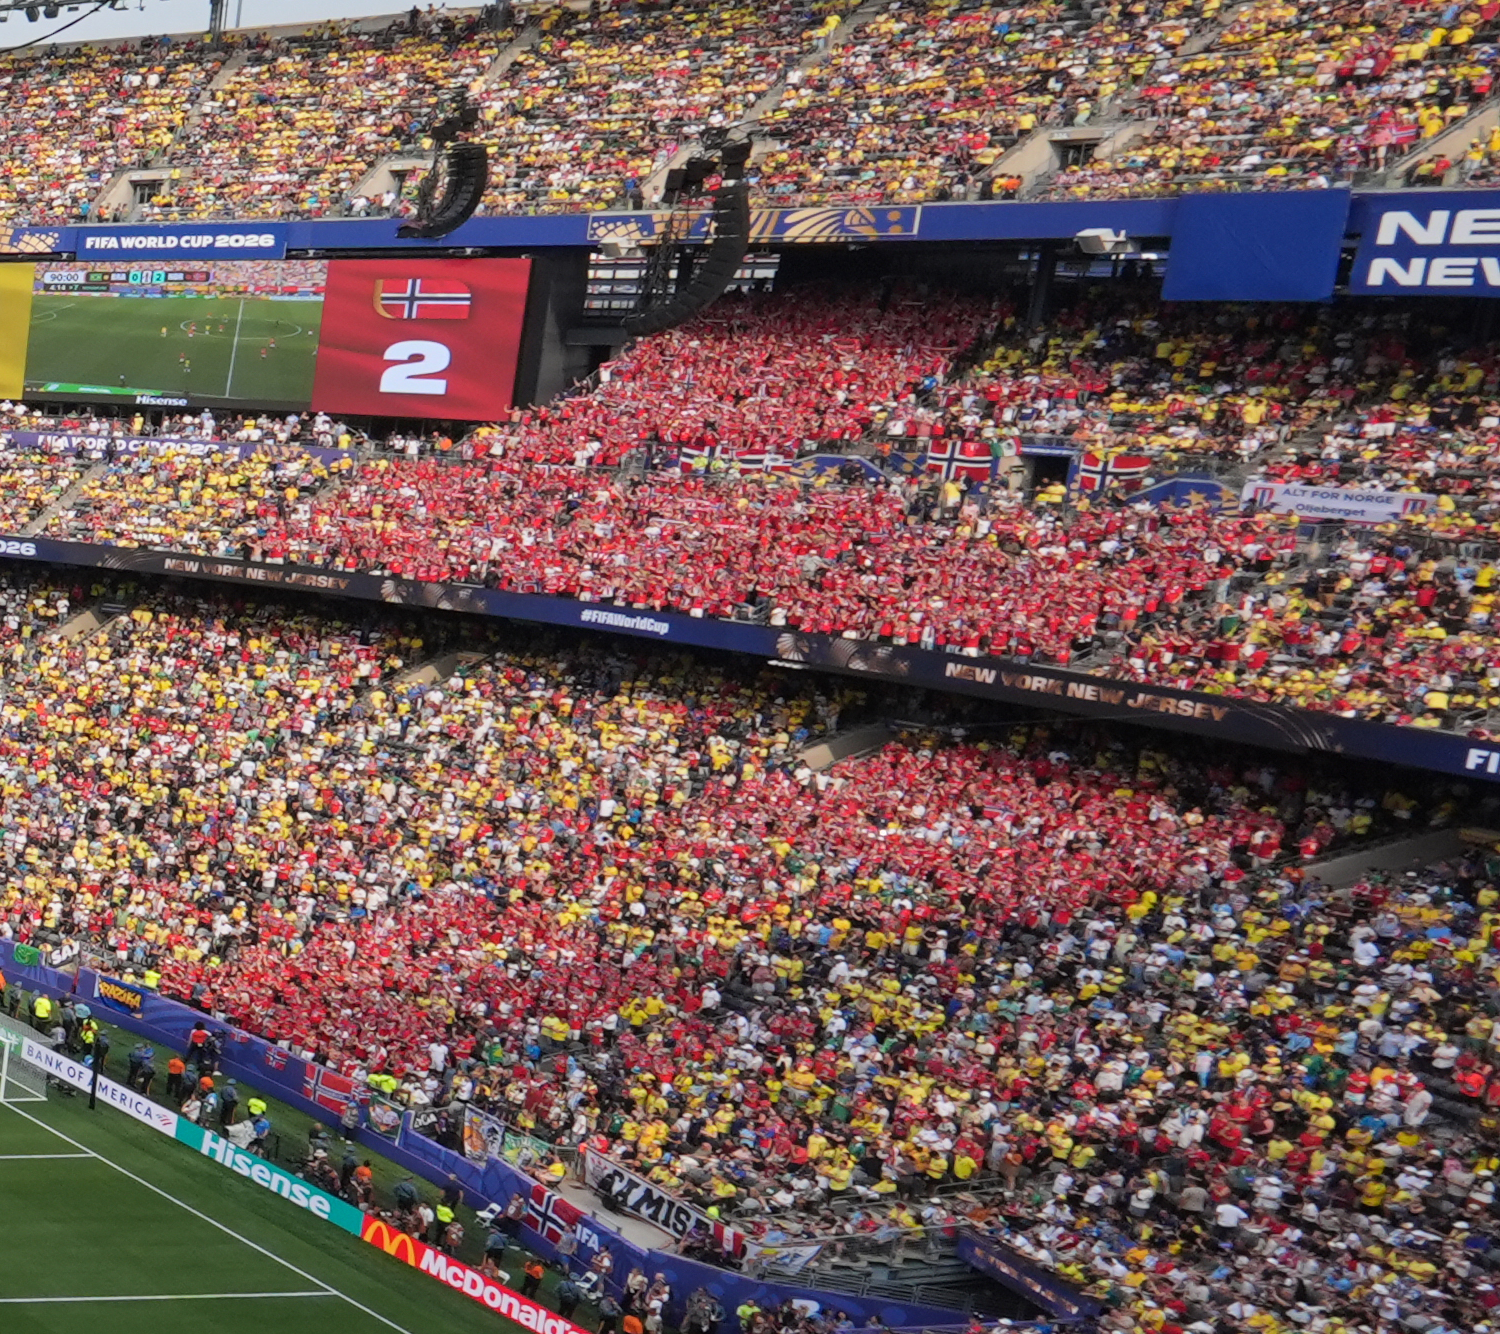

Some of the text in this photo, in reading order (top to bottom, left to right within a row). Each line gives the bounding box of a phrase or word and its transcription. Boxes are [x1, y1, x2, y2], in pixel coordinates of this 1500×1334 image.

[85, 233, 276, 250] FIFA WORLD CUP 2026
[1375, 208, 1500, 246] NE
[378, 339, 452, 395] 2
[135, 395, 188, 406] Hisense
[1281, 488, 1394, 504] ALT FOR NORGE
[163, 558, 350, 590] NEW YORK NEW JERSEY
[580, 609, 669, 635] #FIFAWorldCup
[944, 662, 1228, 722] NEW YORK NEW JERSEY
[26, 1045, 63, 1074] BANK
[66, 1063, 86, 1084] OF
[200, 1129, 331, 1220] Hisense
